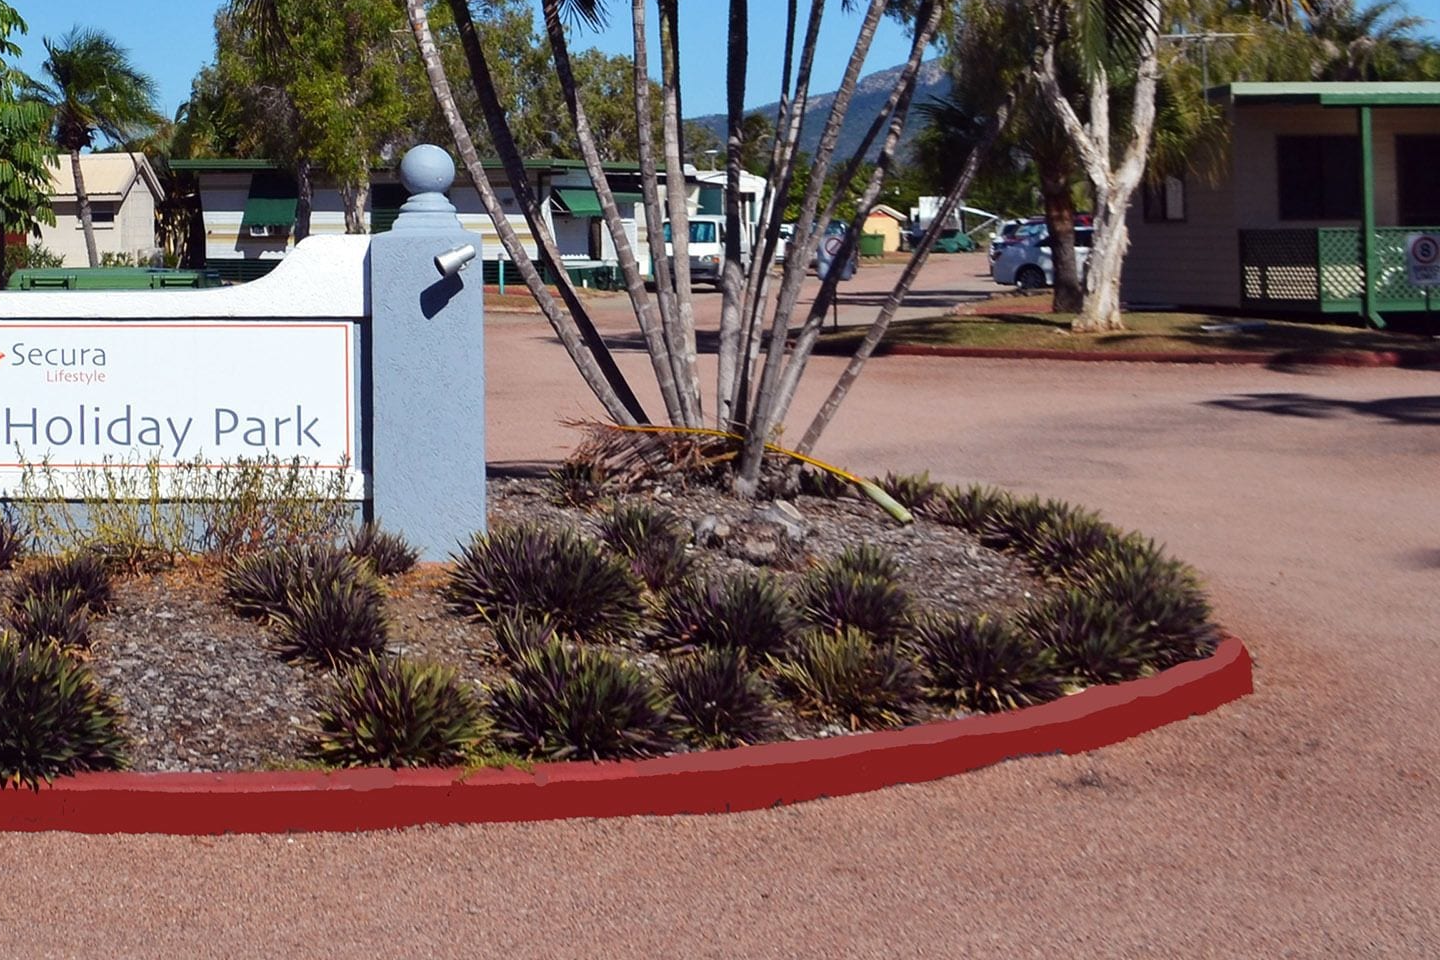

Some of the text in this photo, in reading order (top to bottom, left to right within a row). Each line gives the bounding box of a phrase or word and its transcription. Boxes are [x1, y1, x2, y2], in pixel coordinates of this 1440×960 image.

[11, 342, 106, 367] Secura
[46, 369, 106, 385] Lifestyle
[5, 403, 194, 458] Holiday
[214, 404, 322, 448] Park
